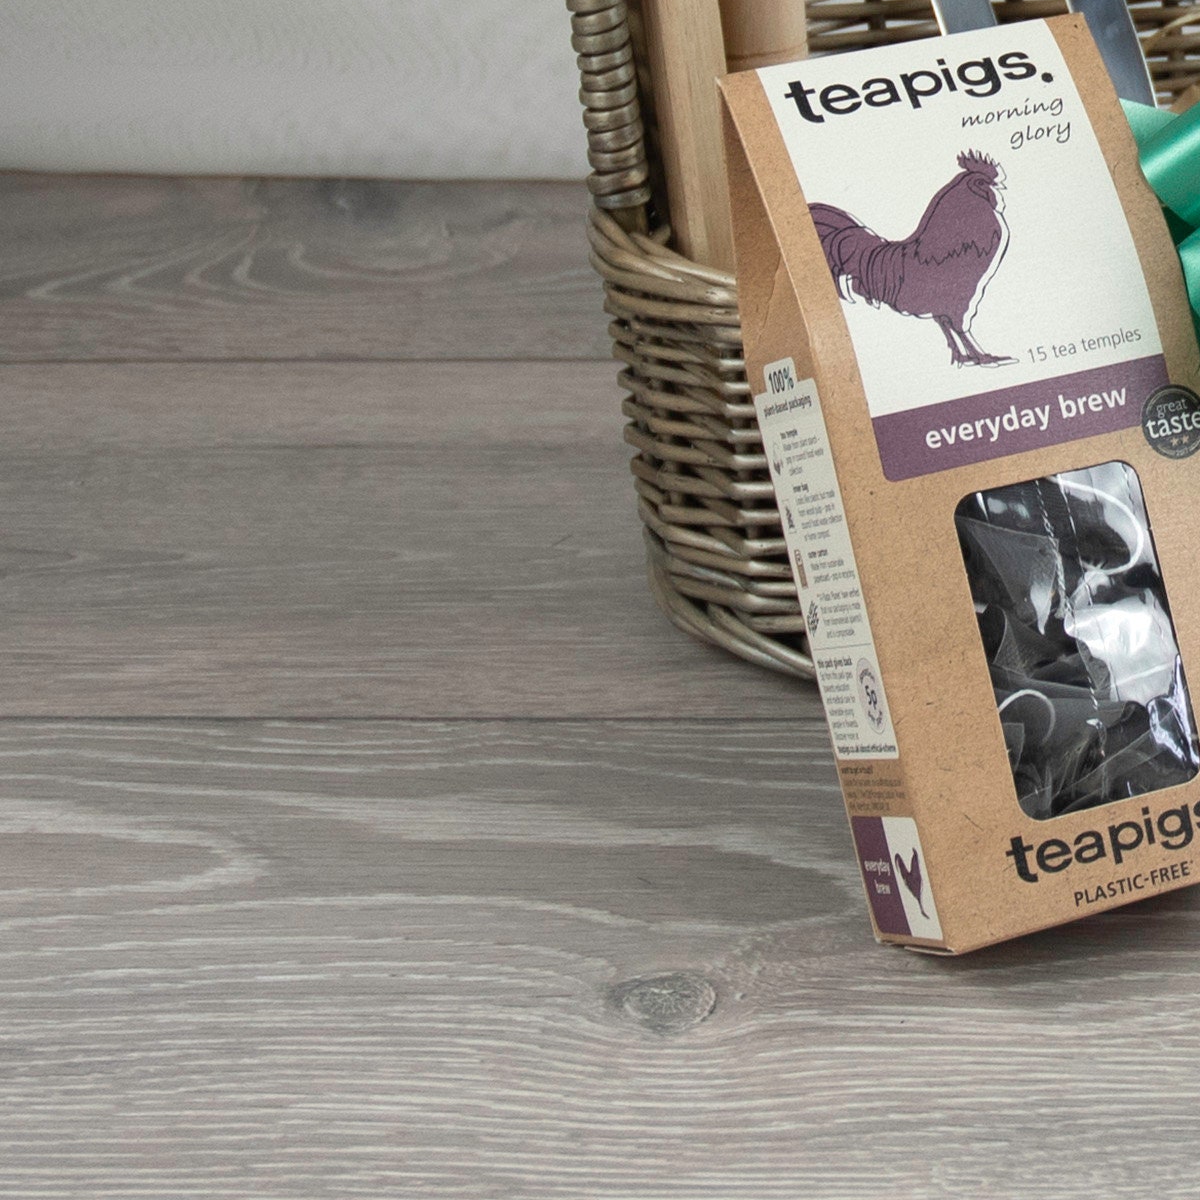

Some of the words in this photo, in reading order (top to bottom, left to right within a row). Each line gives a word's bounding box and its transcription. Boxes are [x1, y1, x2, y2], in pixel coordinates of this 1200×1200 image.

[784, 52, 1054, 124] teapigs.
[961, 98, 1064, 128] morning
[1010, 121, 1072, 150] glory
[1027, 346, 1048, 364] 15
[1052, 341, 1077, 358] tea
[1081, 327, 1143, 353] temples
[768, 365, 795, 395] 100%
[925, 404, 1051, 450] everyday
[1058, 387, 1127, 419] brew
[1156, 399, 1188, 419] great
